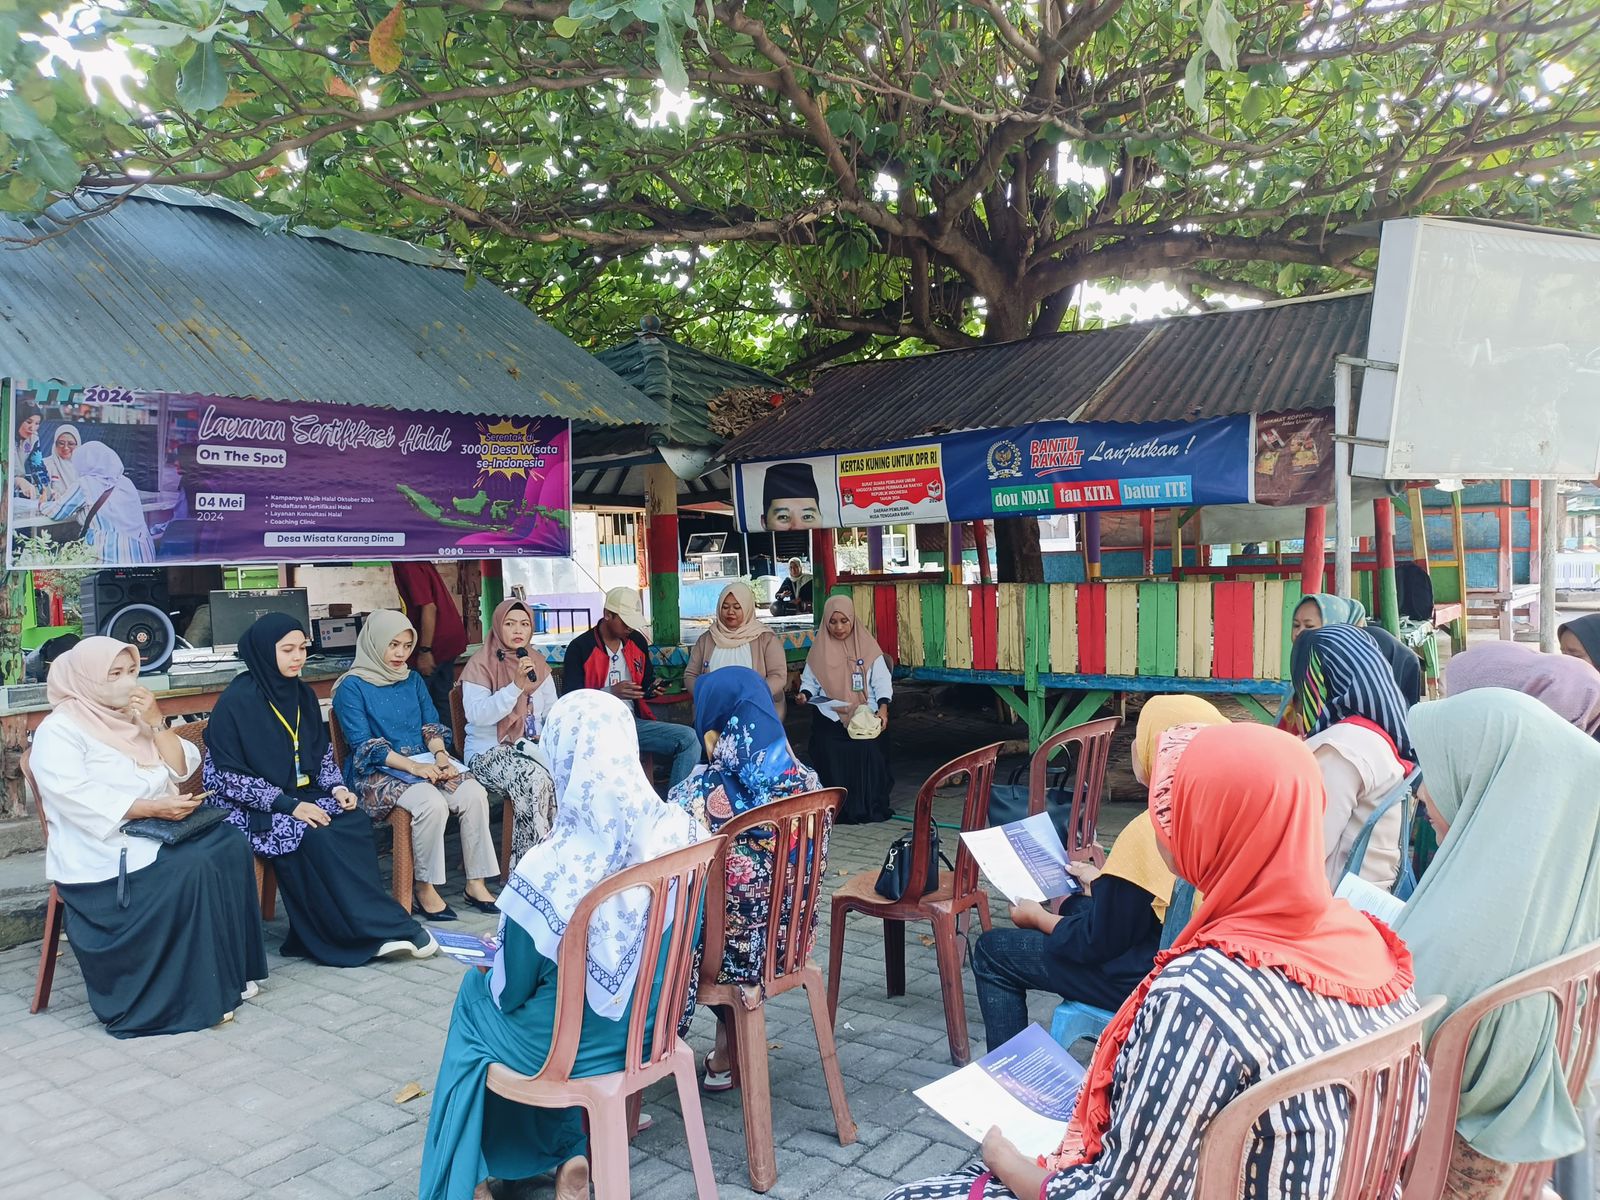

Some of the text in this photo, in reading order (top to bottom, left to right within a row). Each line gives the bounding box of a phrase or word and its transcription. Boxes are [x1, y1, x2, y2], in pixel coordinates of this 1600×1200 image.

[84, 388, 134, 404] 2024
[199, 404, 453, 456] Layanan Sertifikasi Halal
[486, 432, 534, 442] Serentak di
[460, 444, 558, 455] 3000 Desa Wisata
[1030, 436, 1079, 455] BANTU
[1088, 435, 1196, 466] Lanjutkan !
[199, 449, 284, 466] On The Spot
[476, 457, 545, 469] se-Indonesia
[840, 450, 937, 473] KERTAS KUNING UNTUK DPR RI
[1030, 450, 1085, 469] RAKYAT
[270, 494, 302, 502] Kampanye
[994, 481, 1187, 507] dou NDAI tau KITA batur ITE
[198, 496, 243, 508] 04 Mei
[196, 511, 224, 522] 2024
[270, 518, 298, 526] Coaching
[277, 534, 394, 545] Desa Wisata Karang Dima
